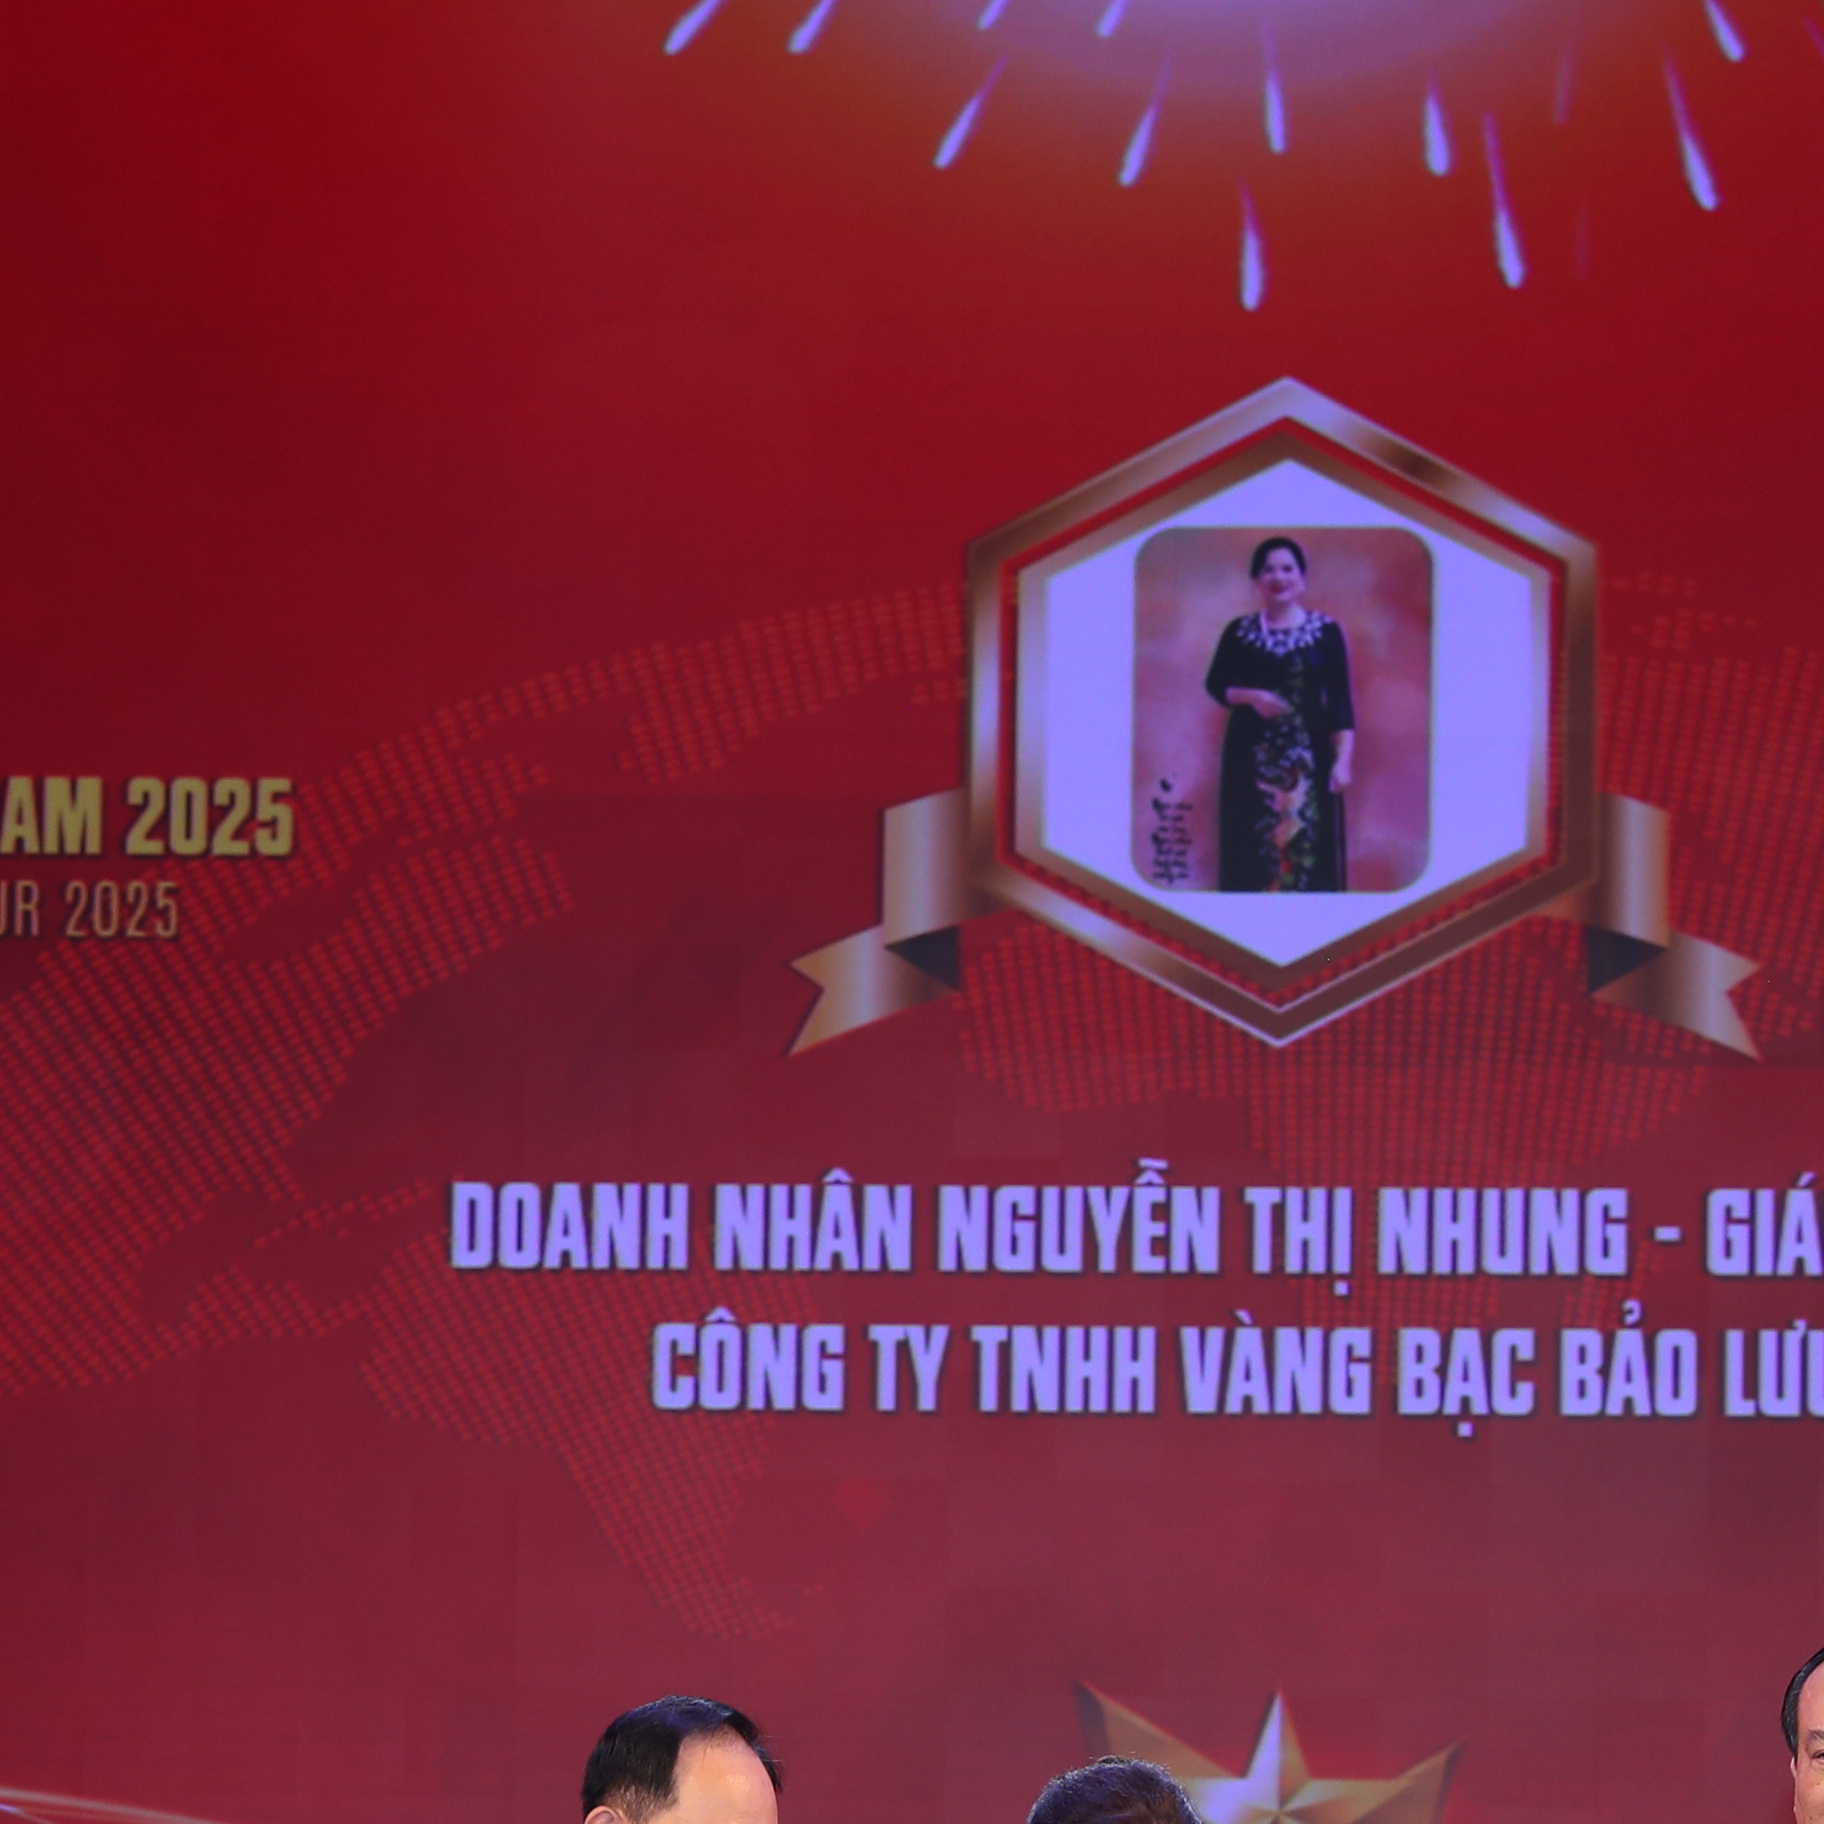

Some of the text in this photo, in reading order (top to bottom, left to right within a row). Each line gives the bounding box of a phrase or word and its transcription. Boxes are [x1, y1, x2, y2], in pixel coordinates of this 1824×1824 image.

[125, 777, 294, 857] 2025
[64, 881, 177, 938] 2025
[450, 1181, 689, 1271] DOANH
[713, 1167, 913, 1272] NHÂN
[936, 1158, 1221, 1274] NGUYỄN
[1244, 1186, 1353, 1296] THỊ
[1378, 1186, 1629, 1275] NHUNG
[1653, 1226, 1682, 1242] -
[651, 1306, 845, 1411] CÔNG
[867, 1323, 949, 1413] TY
[970, 1324, 1157, 1414] TNHH
[1180, 1309, 1372, 1416] VÀNG
[1397, 1327, 1536, 1437] BẠC
[1559, 1300, 1699, 1416] BẢO
